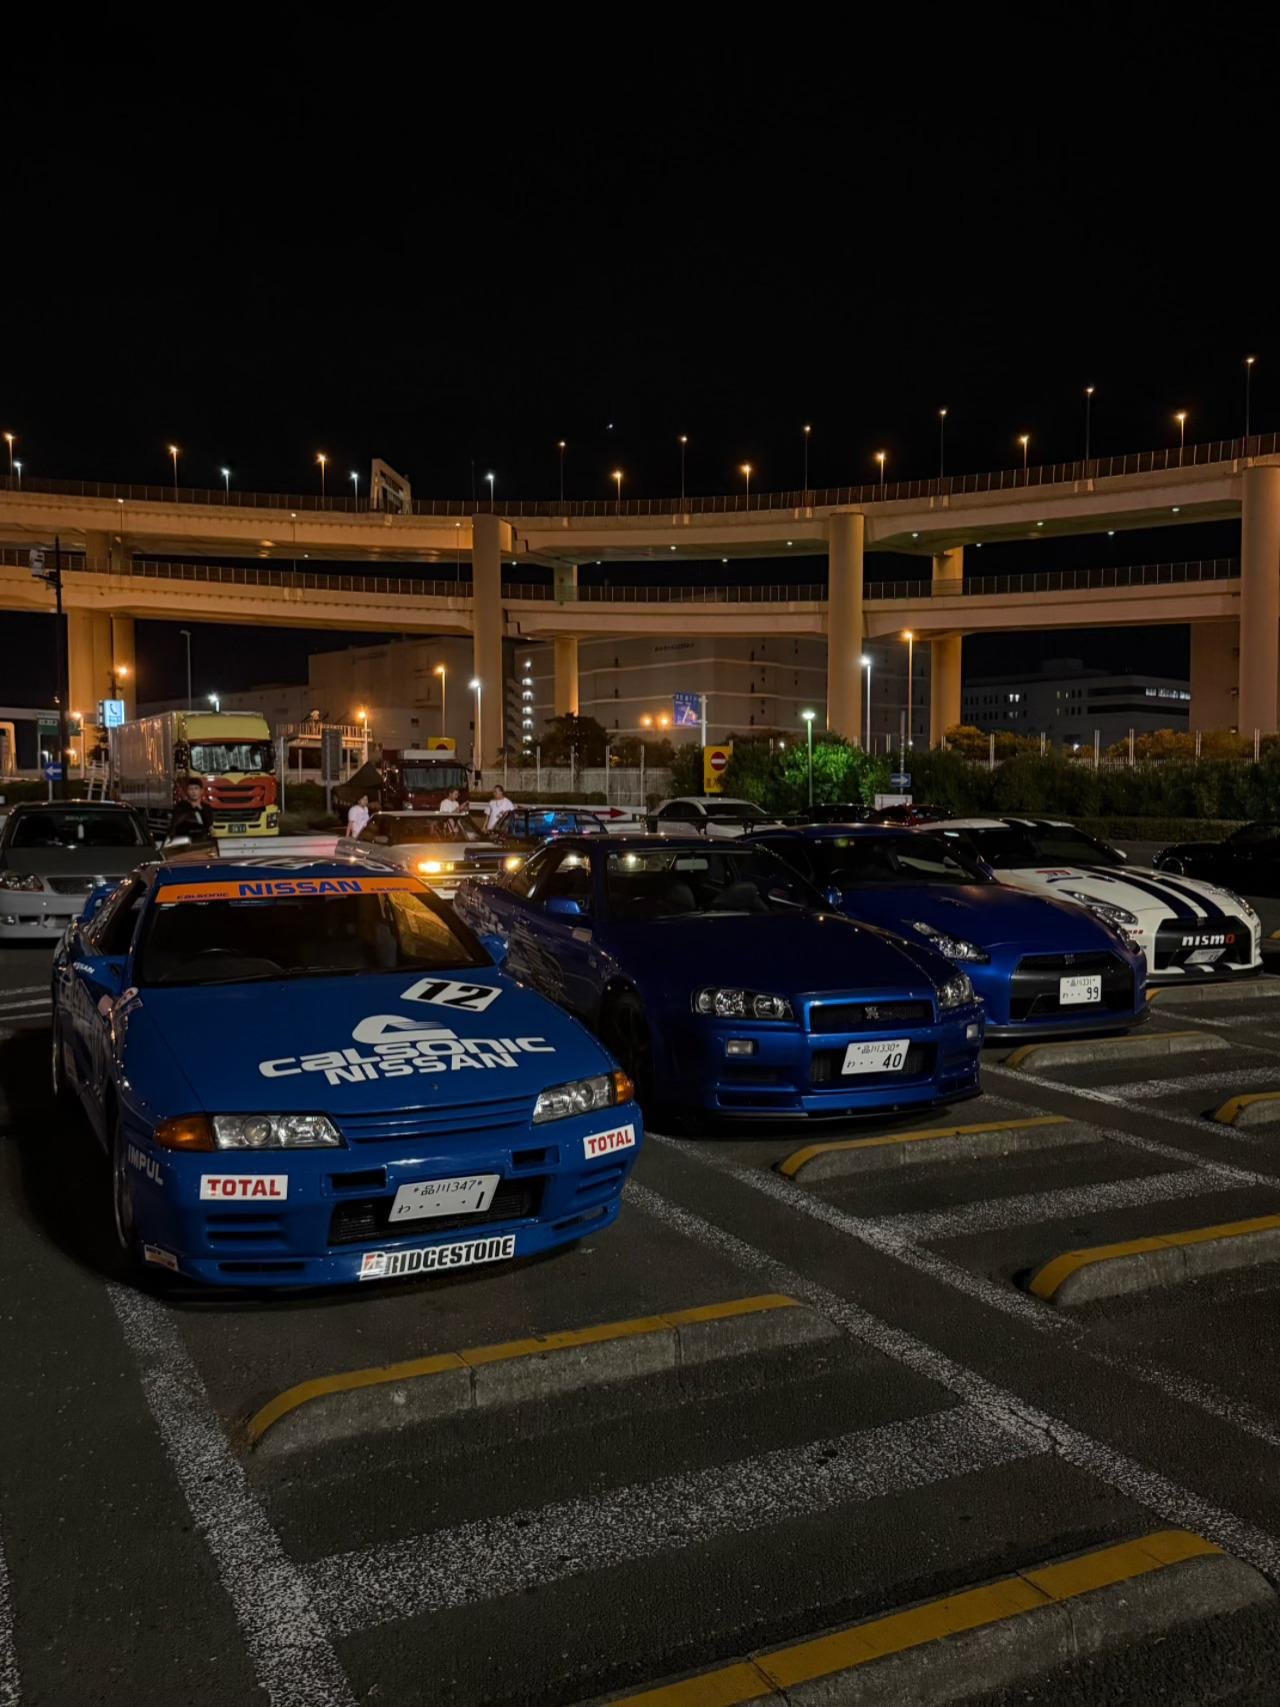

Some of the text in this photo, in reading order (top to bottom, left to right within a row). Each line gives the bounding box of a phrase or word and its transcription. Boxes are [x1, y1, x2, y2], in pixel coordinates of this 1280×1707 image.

[239, 881, 362, 896] NISSAN
[417, 981, 494, 1010] 12
[1086, 986, 1099, 1001] 99
[324, 1053, 519, 1085] NISSAN
[882, 1052, 903, 1069] 40
[588, 1130, 632, 1154] TOTAL
[128, 1144, 164, 1185] IMPUL
[207, 1179, 281, 1196] TOTAL
[420, 1180, 477, 1196] 品川347
[362, 1238, 513, 1279] BRIDGESTONE
